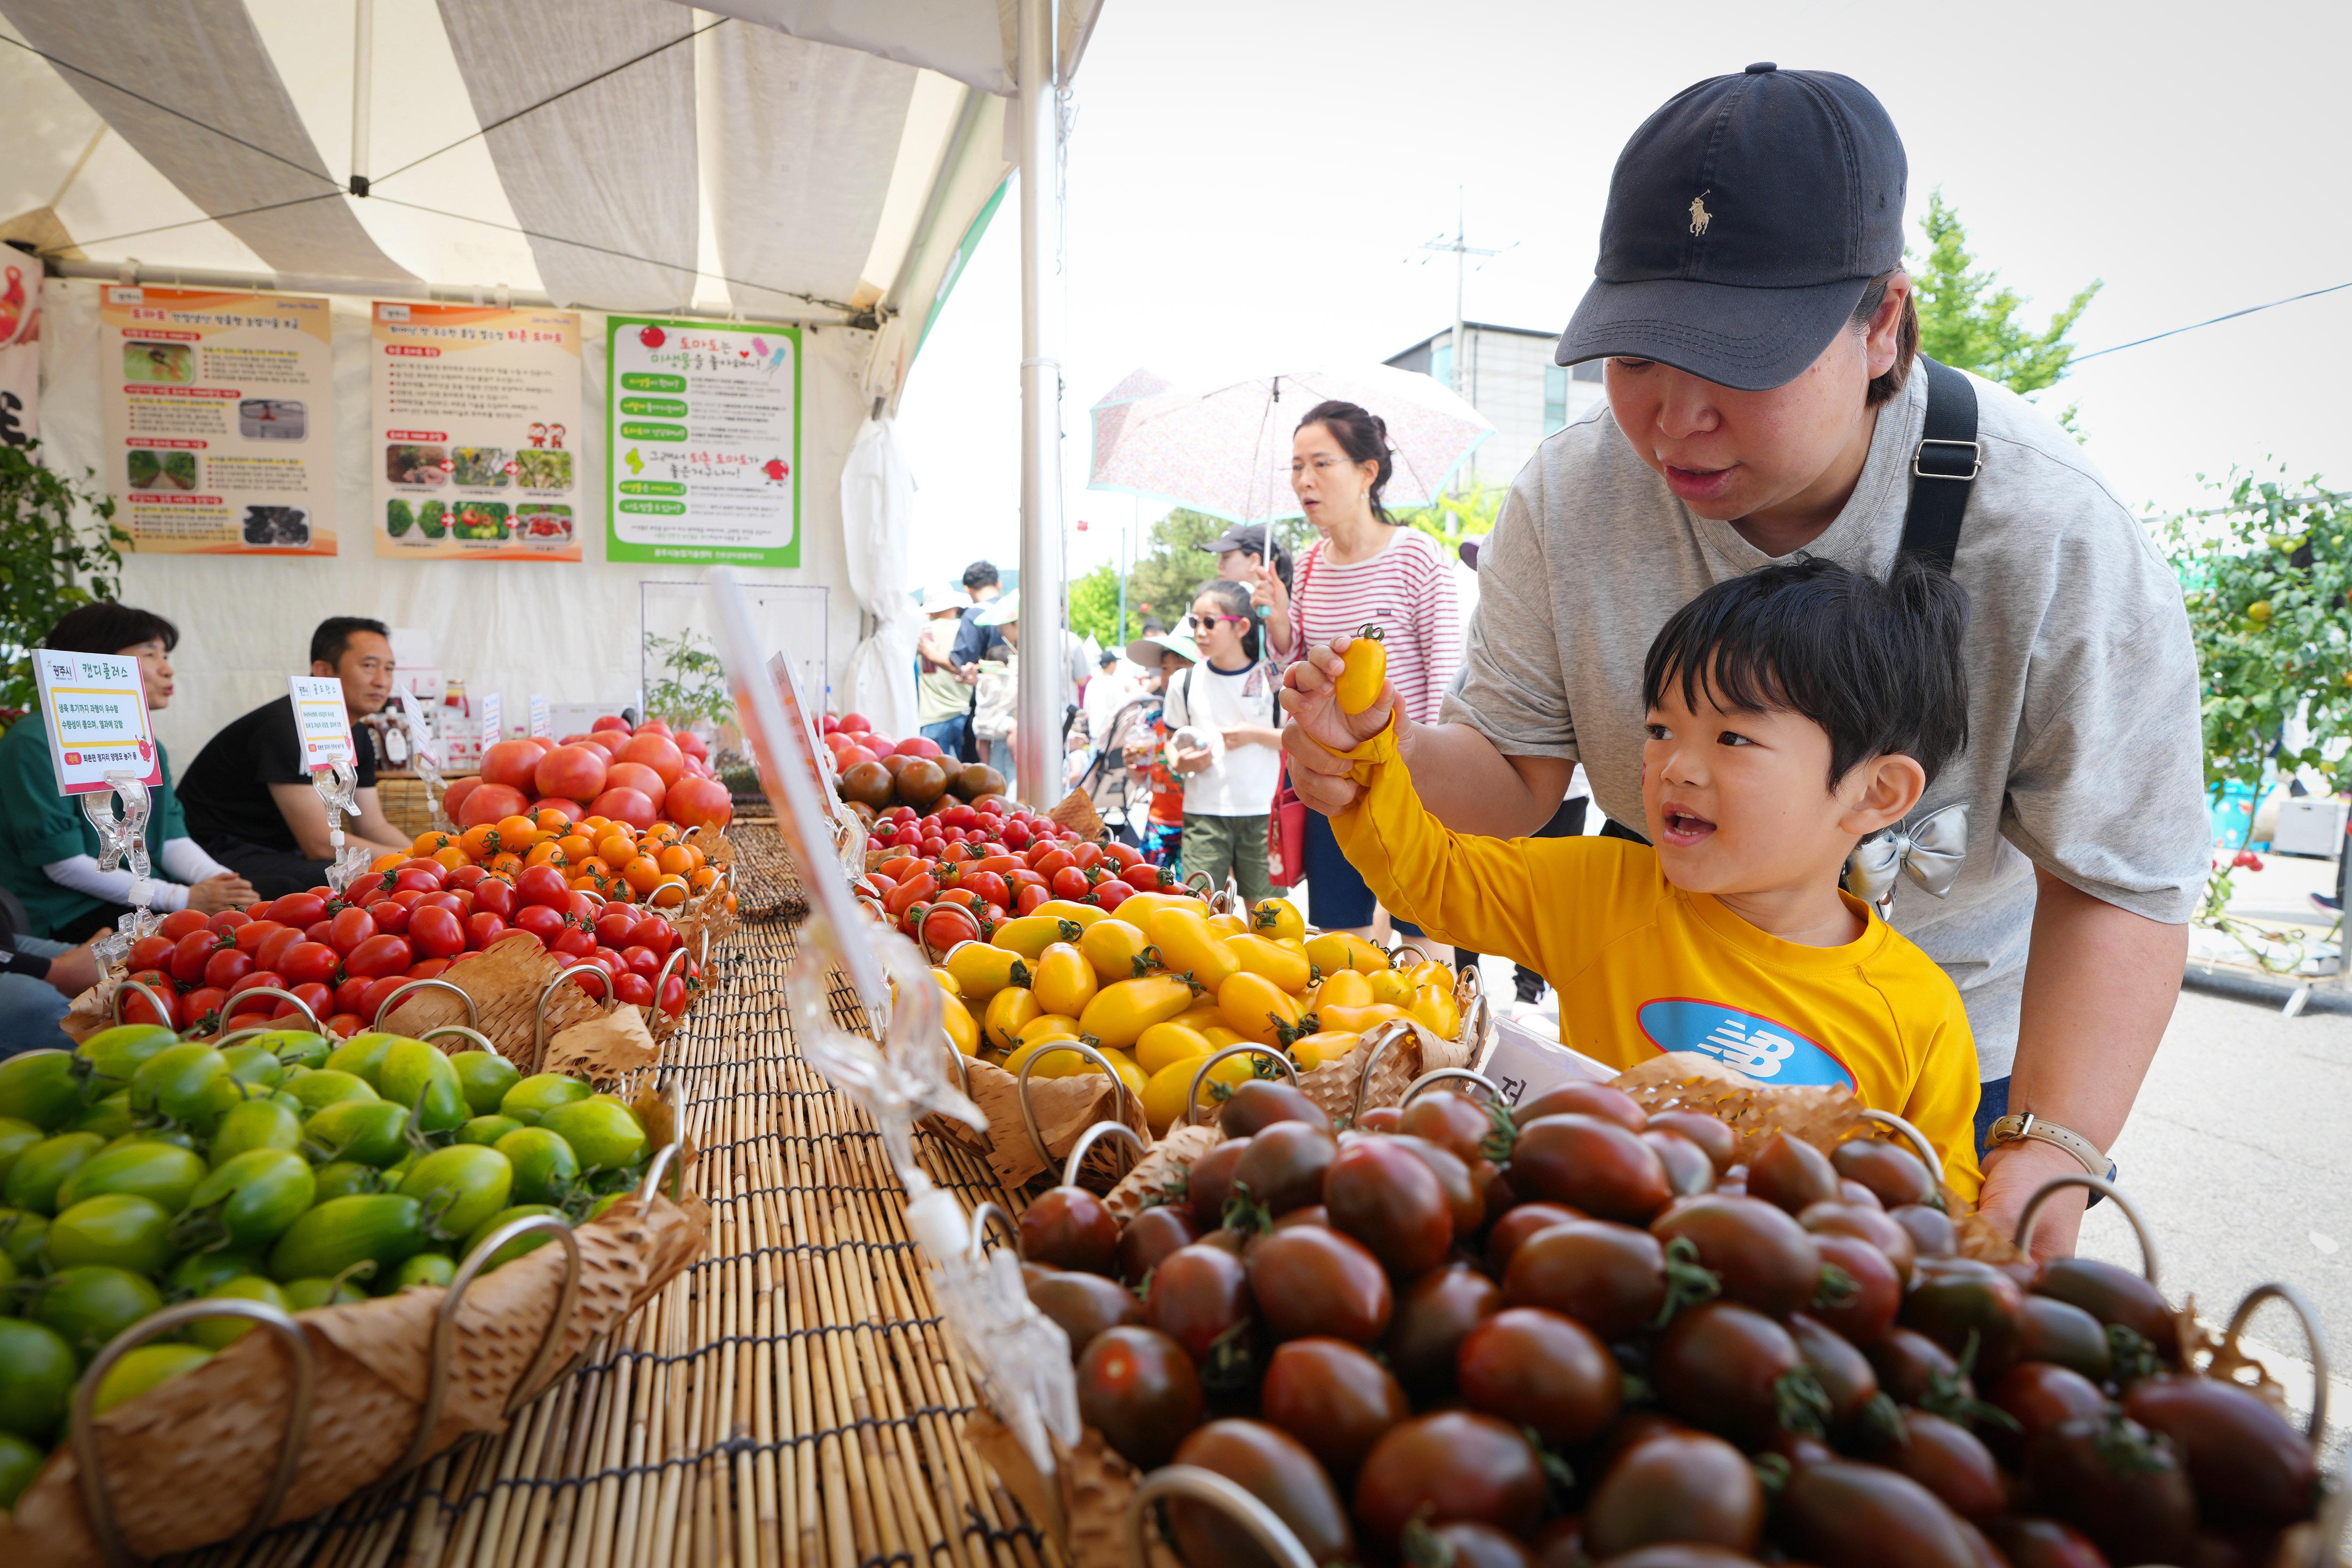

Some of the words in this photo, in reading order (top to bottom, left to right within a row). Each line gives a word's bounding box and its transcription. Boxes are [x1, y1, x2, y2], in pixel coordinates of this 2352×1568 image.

[133, 309, 165, 320] 토마토
[508, 329, 527, 342] 퇴촌
[534, 332, 562, 343] 토마토
[680, 336, 732, 355] 토마토는
[651, 353, 704, 371] 미생물을
[649, 451, 686, 462] 그래서
[690, 451, 712, 467] 퇴촌
[716, 452, 760, 465] 토마토가
[53, 665, 72, 677] 광주시
[82, 662, 128, 679] 캔디플러스
[58, 704, 69, 713] 생육
[70, 704, 89, 713] 후기까지
[90, 704, 104, 713] 과형이
[105, 705, 119, 714] 우수함
[62, 720, 82, 730] 수량성이
[82, 720, 98, 729] 좋으며,
[99, 720, 113, 729] 열과에
[114, 720, 123, 729] 강함
[68, 754, 79, 764] 재배
[83, 754, 96, 763] 퇴촌면
[97, 753, 110, 762] 정지리
[132, 752, 137, 760] 등
